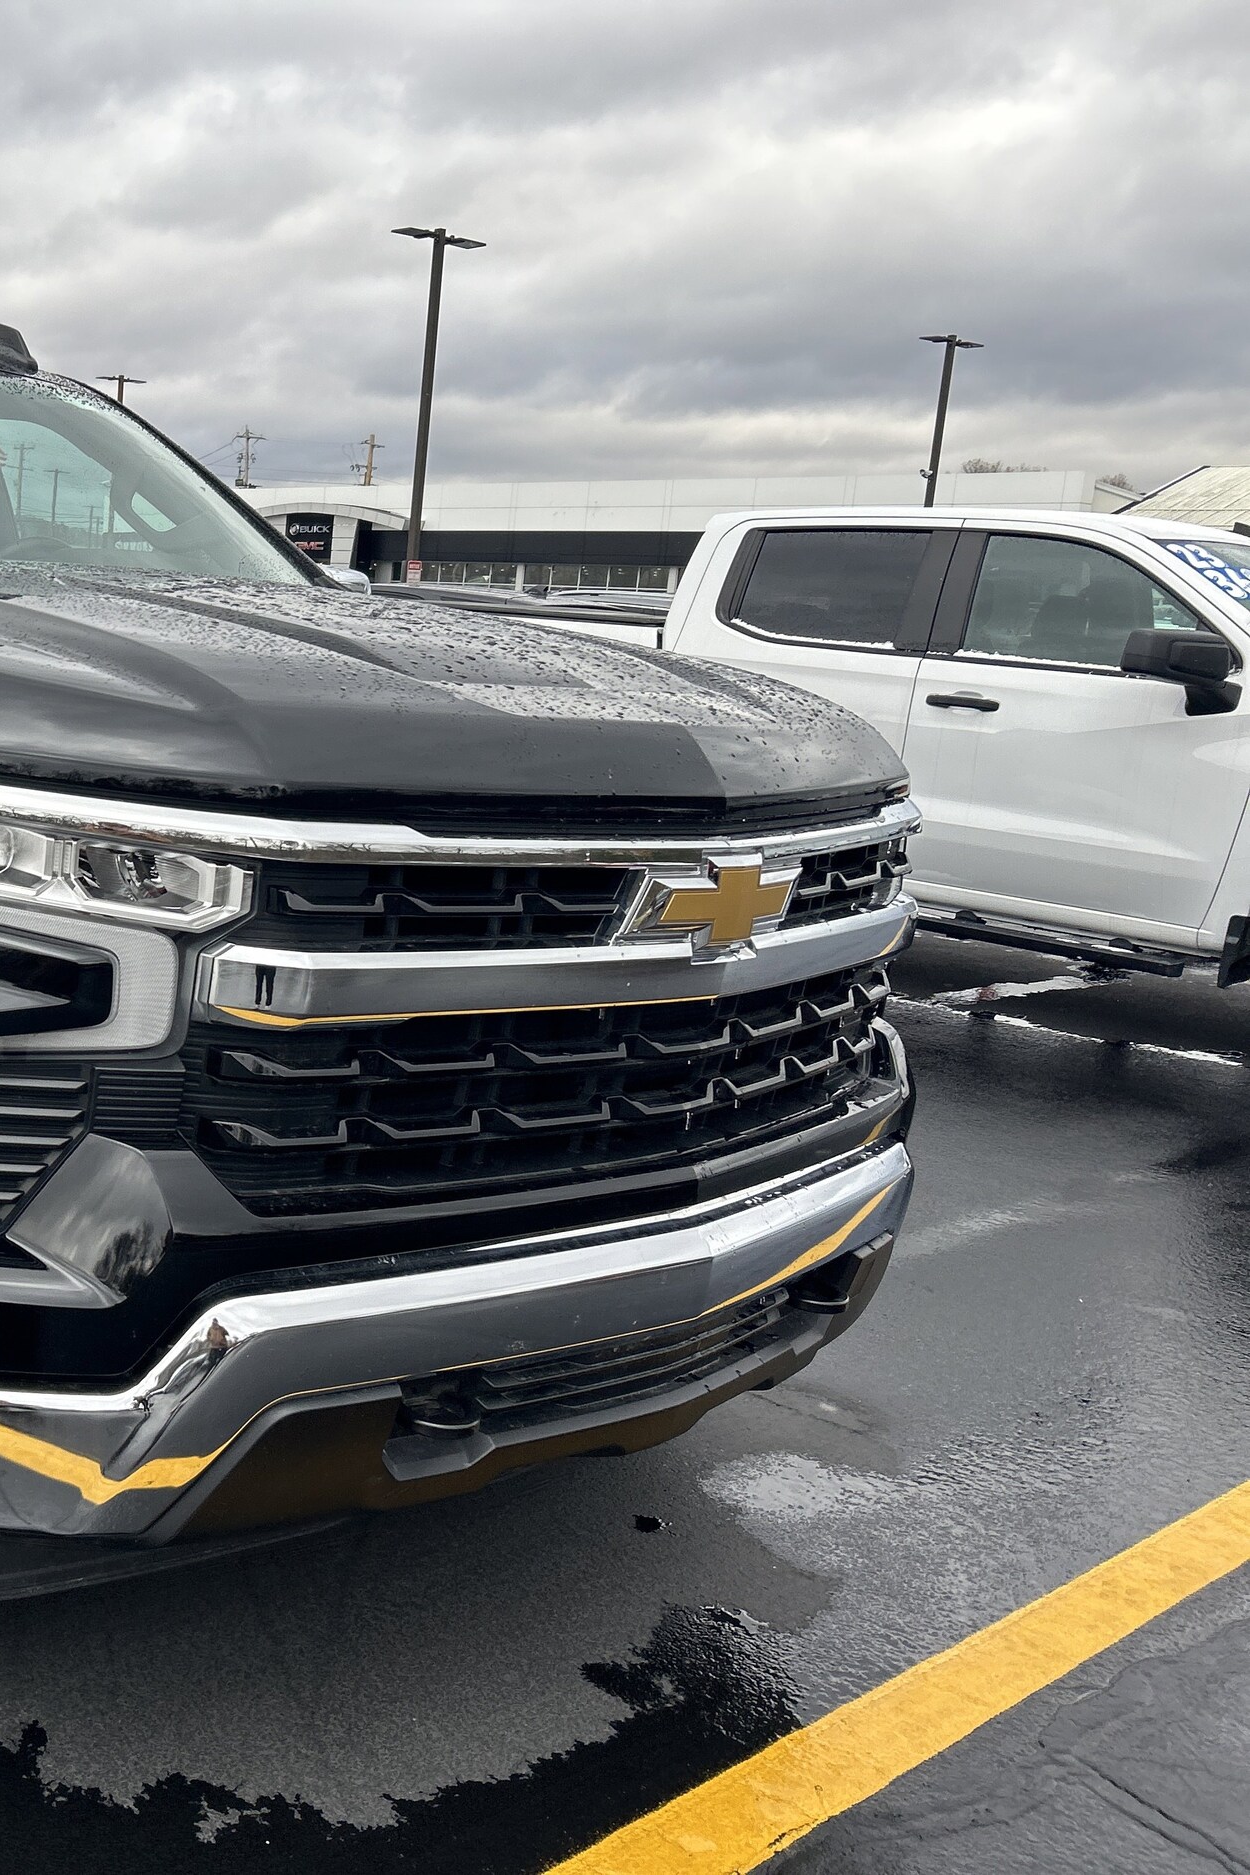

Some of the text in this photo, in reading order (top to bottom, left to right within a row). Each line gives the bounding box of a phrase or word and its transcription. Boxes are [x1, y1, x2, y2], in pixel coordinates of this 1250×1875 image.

[299, 525, 330, 534] BUICK
[294, 541, 324, 551] GMC
[1166, 543, 1229, 569] 23
